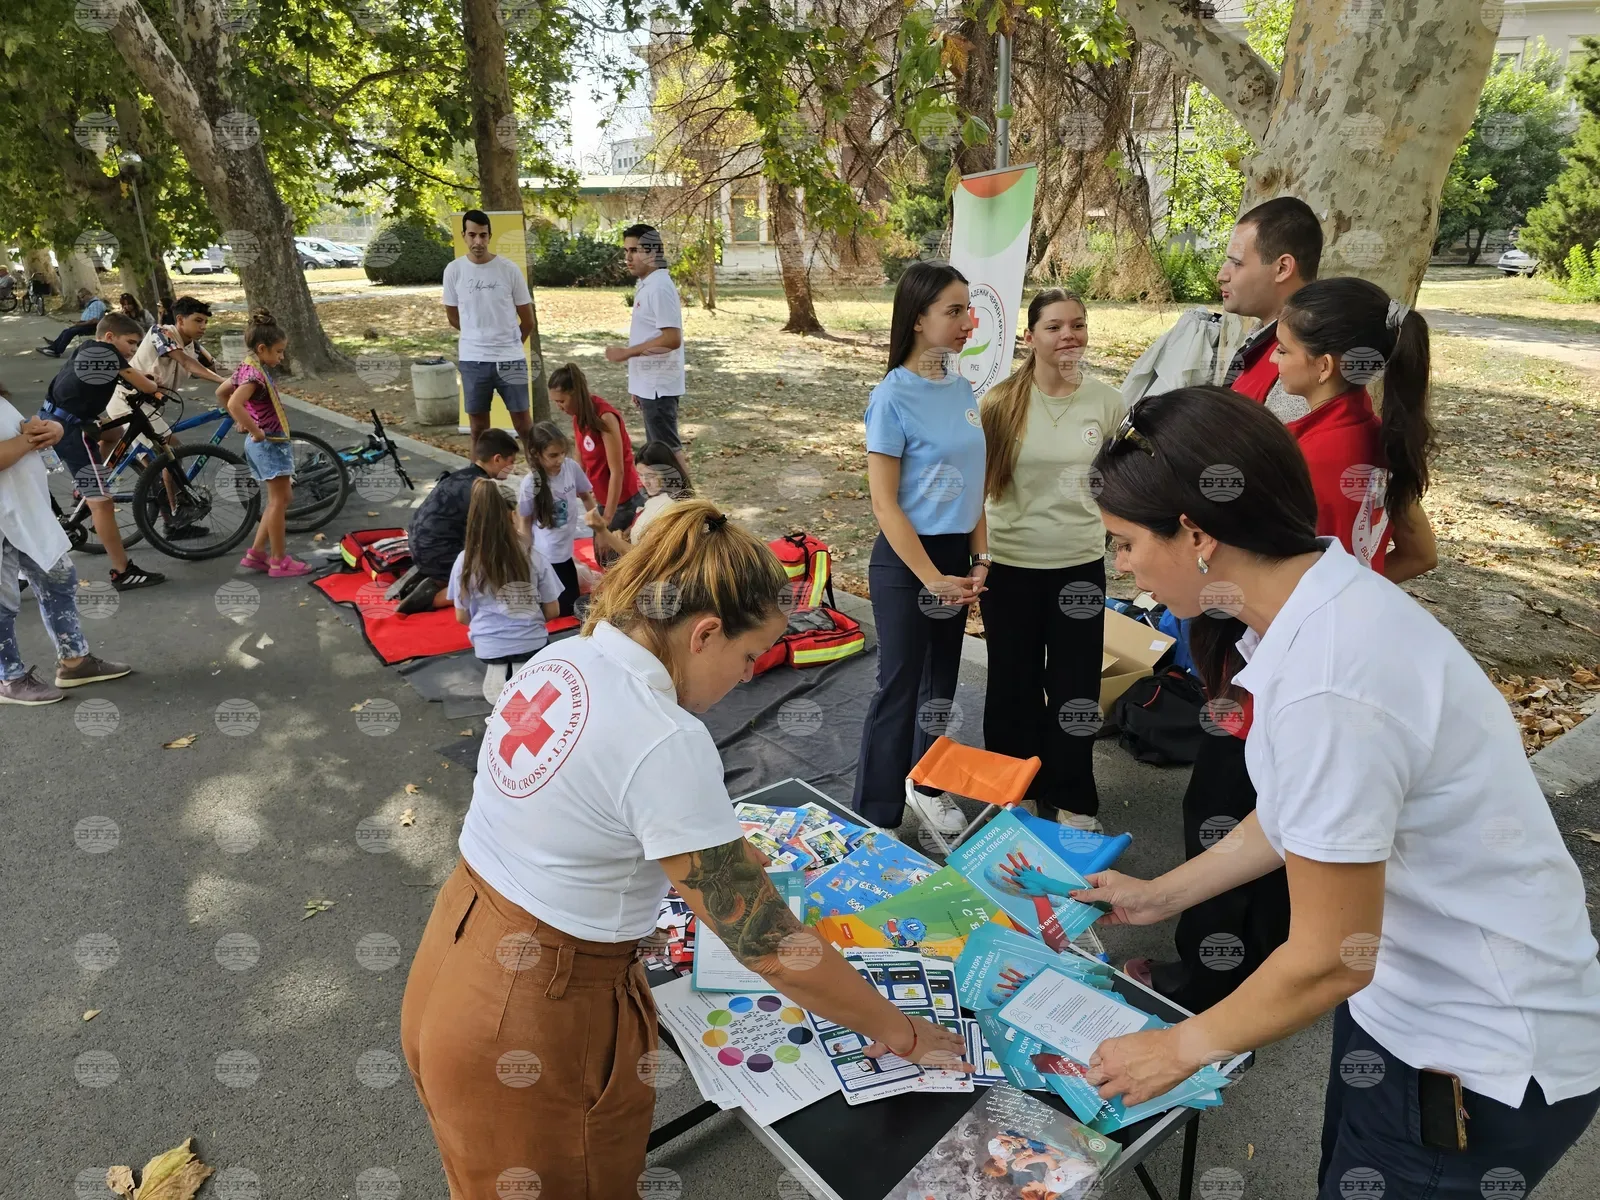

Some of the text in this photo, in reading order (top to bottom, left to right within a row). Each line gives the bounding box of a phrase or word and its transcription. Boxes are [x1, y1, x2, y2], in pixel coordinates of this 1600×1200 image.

[970, 288, 989, 299] АДЕЖКИ
[562, 668, 582, 709] ЧЕРВЕН
[552, 711, 581, 758] КРЪСТ
[501, 773, 517, 791] RED
[518, 762, 548, 792] CROSS
[962, 826, 1001, 860] ВСИЧКИ ХОРА
[977, 826, 1015, 865] ДА СПАСЯВАТ
[1036, 922, 1045, 932] 16
[1043, 902, 1070, 928] октомври
[959, 954, 983, 993] ВСИЧКИ ХОРА
[976, 950, 996, 990] ДА СПАСЯВАТ
[1099, 1110, 1109, 1120] day
